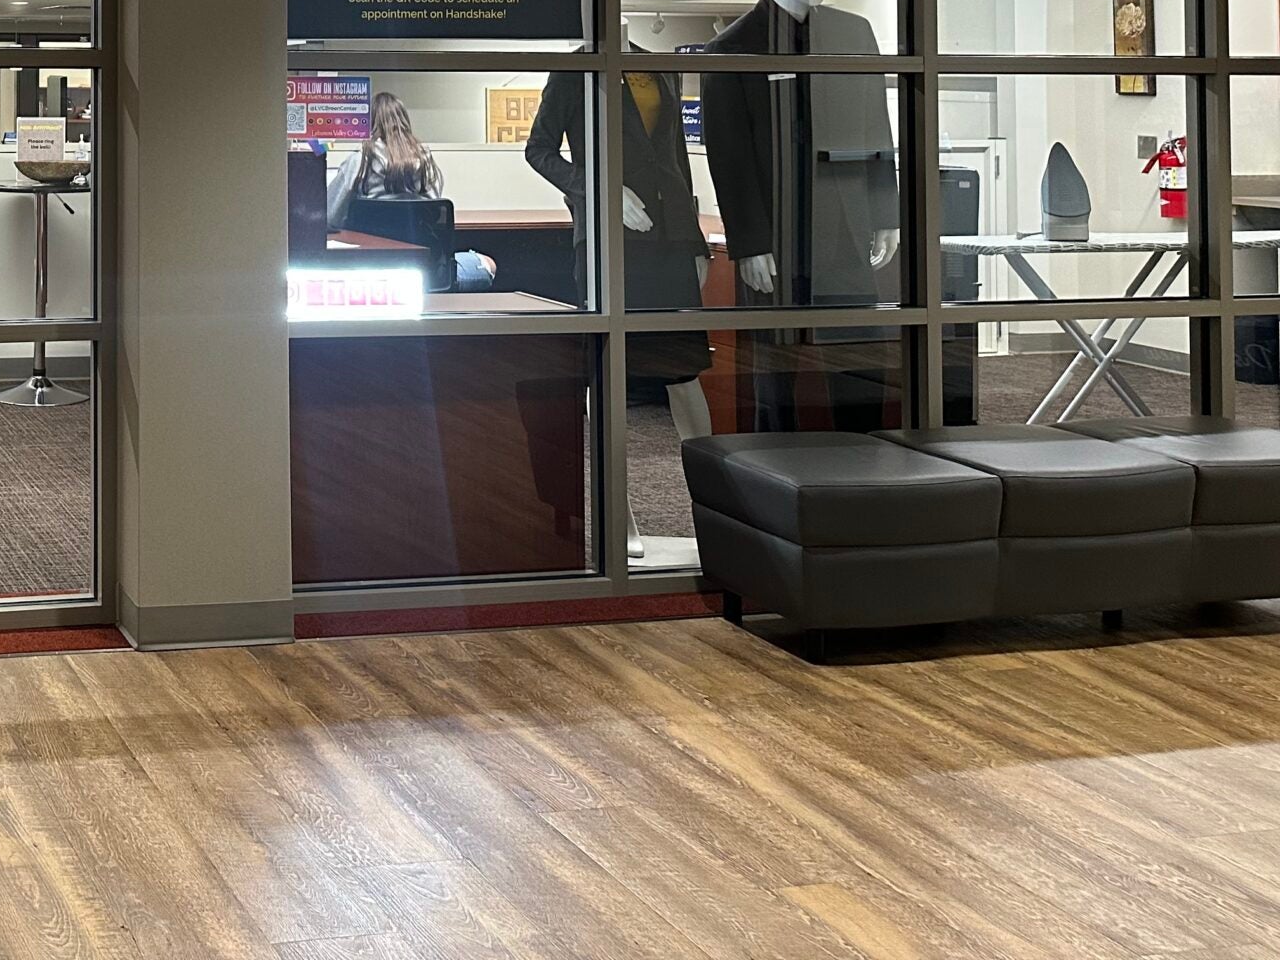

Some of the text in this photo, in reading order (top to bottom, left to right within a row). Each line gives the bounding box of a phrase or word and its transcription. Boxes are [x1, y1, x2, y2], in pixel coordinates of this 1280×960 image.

[361, 9, 428, 21] appointment
[446, 9, 507, 19] Handshake!
[298, 82, 368, 94] FOLLOW ON INSTAGRAM
